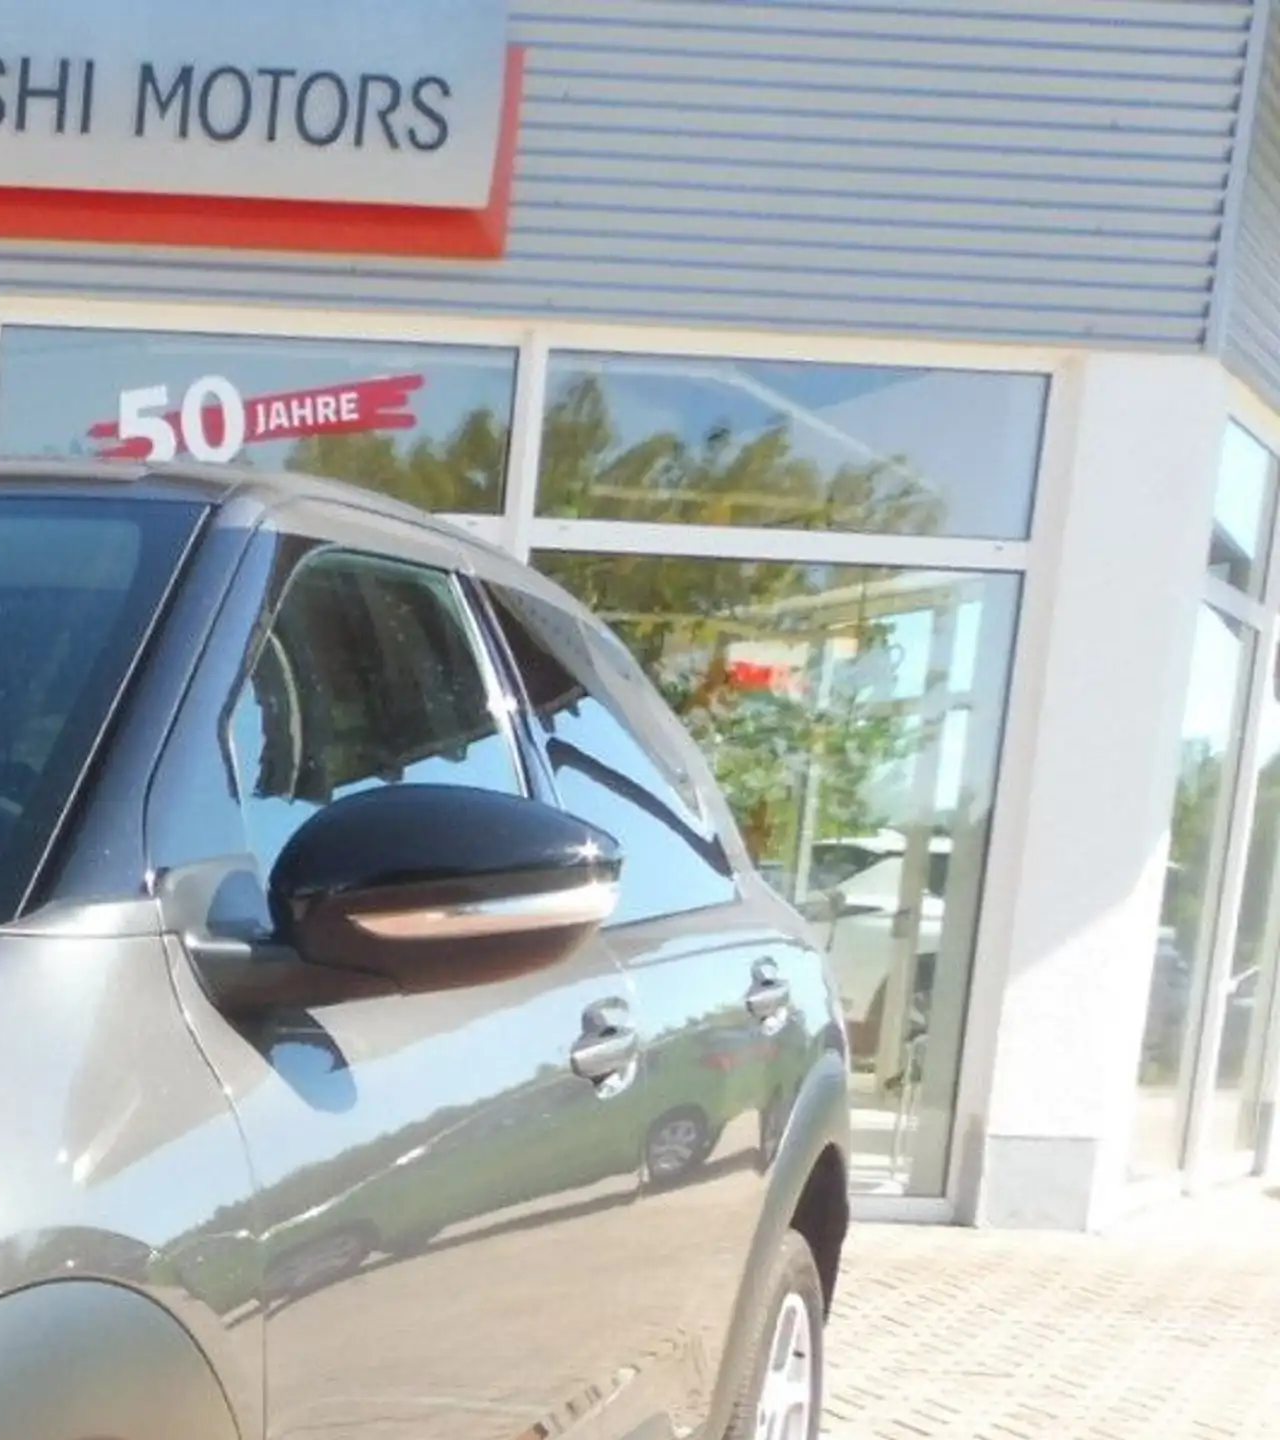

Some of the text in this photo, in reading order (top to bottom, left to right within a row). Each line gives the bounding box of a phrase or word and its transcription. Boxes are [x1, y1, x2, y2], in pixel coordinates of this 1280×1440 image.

[134, 63, 451, 151] MOTORS
[119, 374, 360, 463] 50 JAHRE
